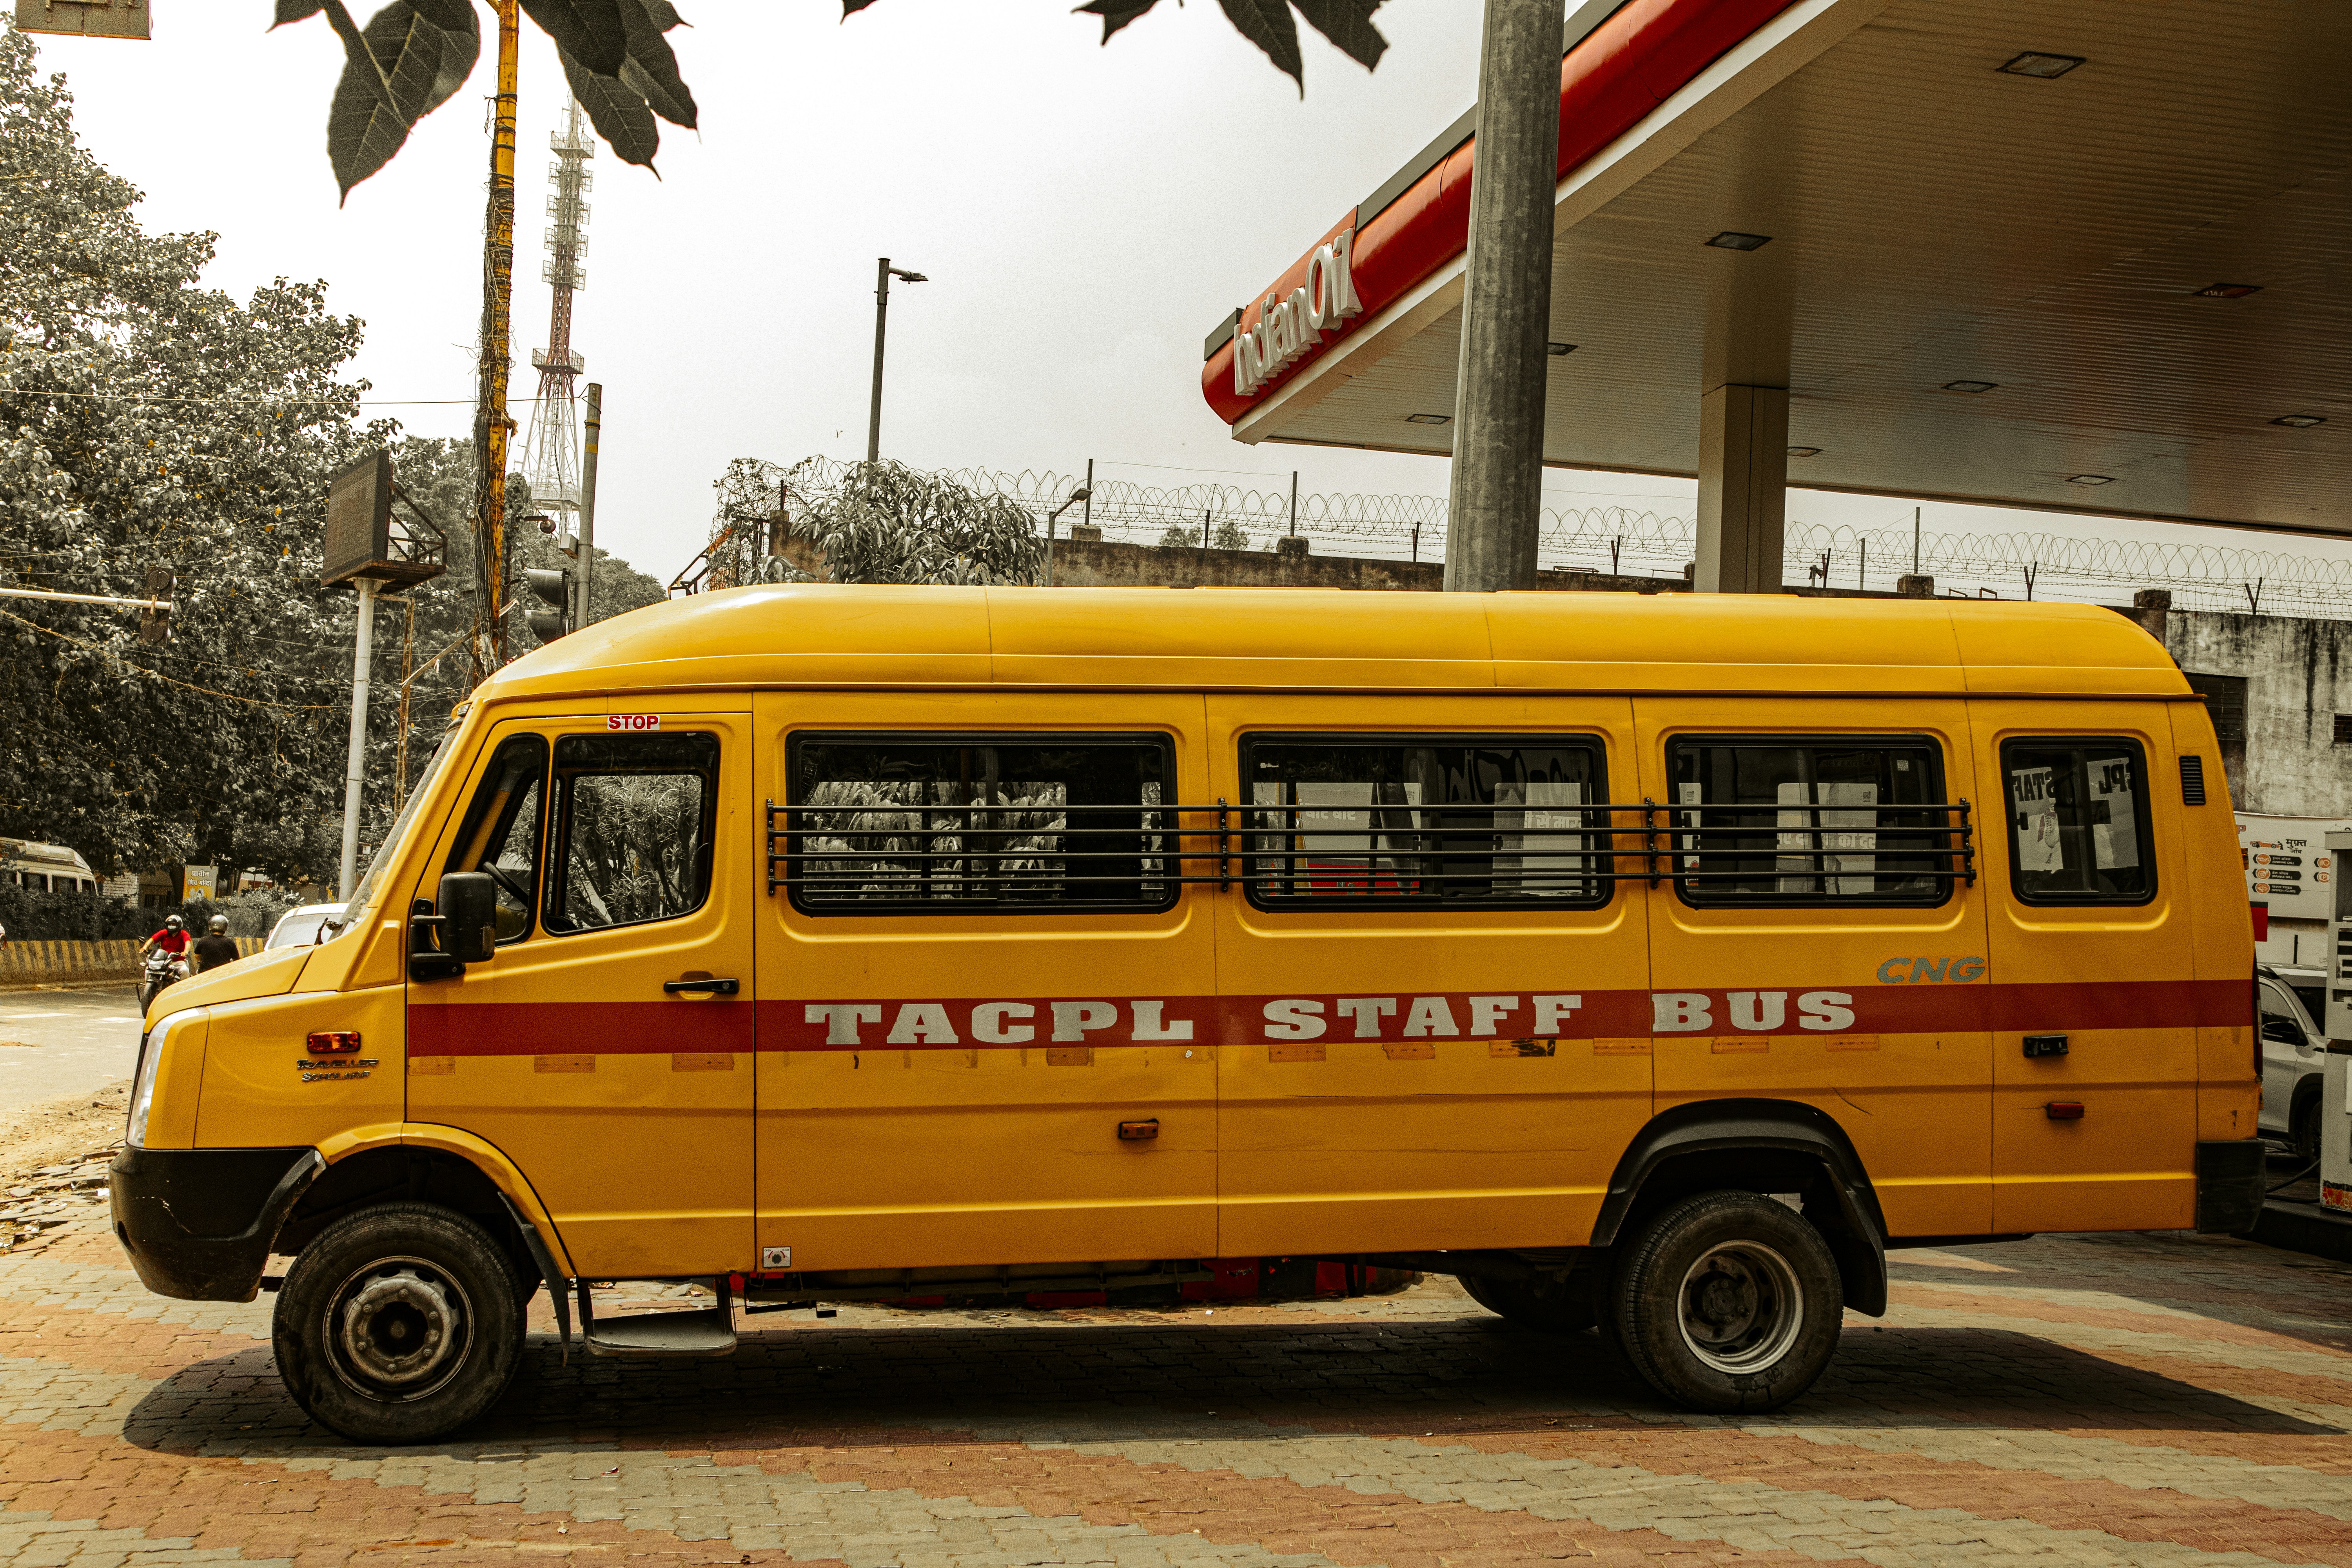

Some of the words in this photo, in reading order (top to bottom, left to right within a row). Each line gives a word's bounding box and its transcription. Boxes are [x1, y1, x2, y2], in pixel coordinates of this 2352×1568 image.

[1234, 228, 1363, 396] IndianOil
[608, 715, 659, 730] STOP
[1877, 956, 1985, 984] CNG
[805, 1000, 1193, 1045] TACPL
[1263, 995, 1582, 1040] STAFF
[1651, 991, 1855, 1032] BUS
[296, 1058, 379, 1070] TRAVELLER
